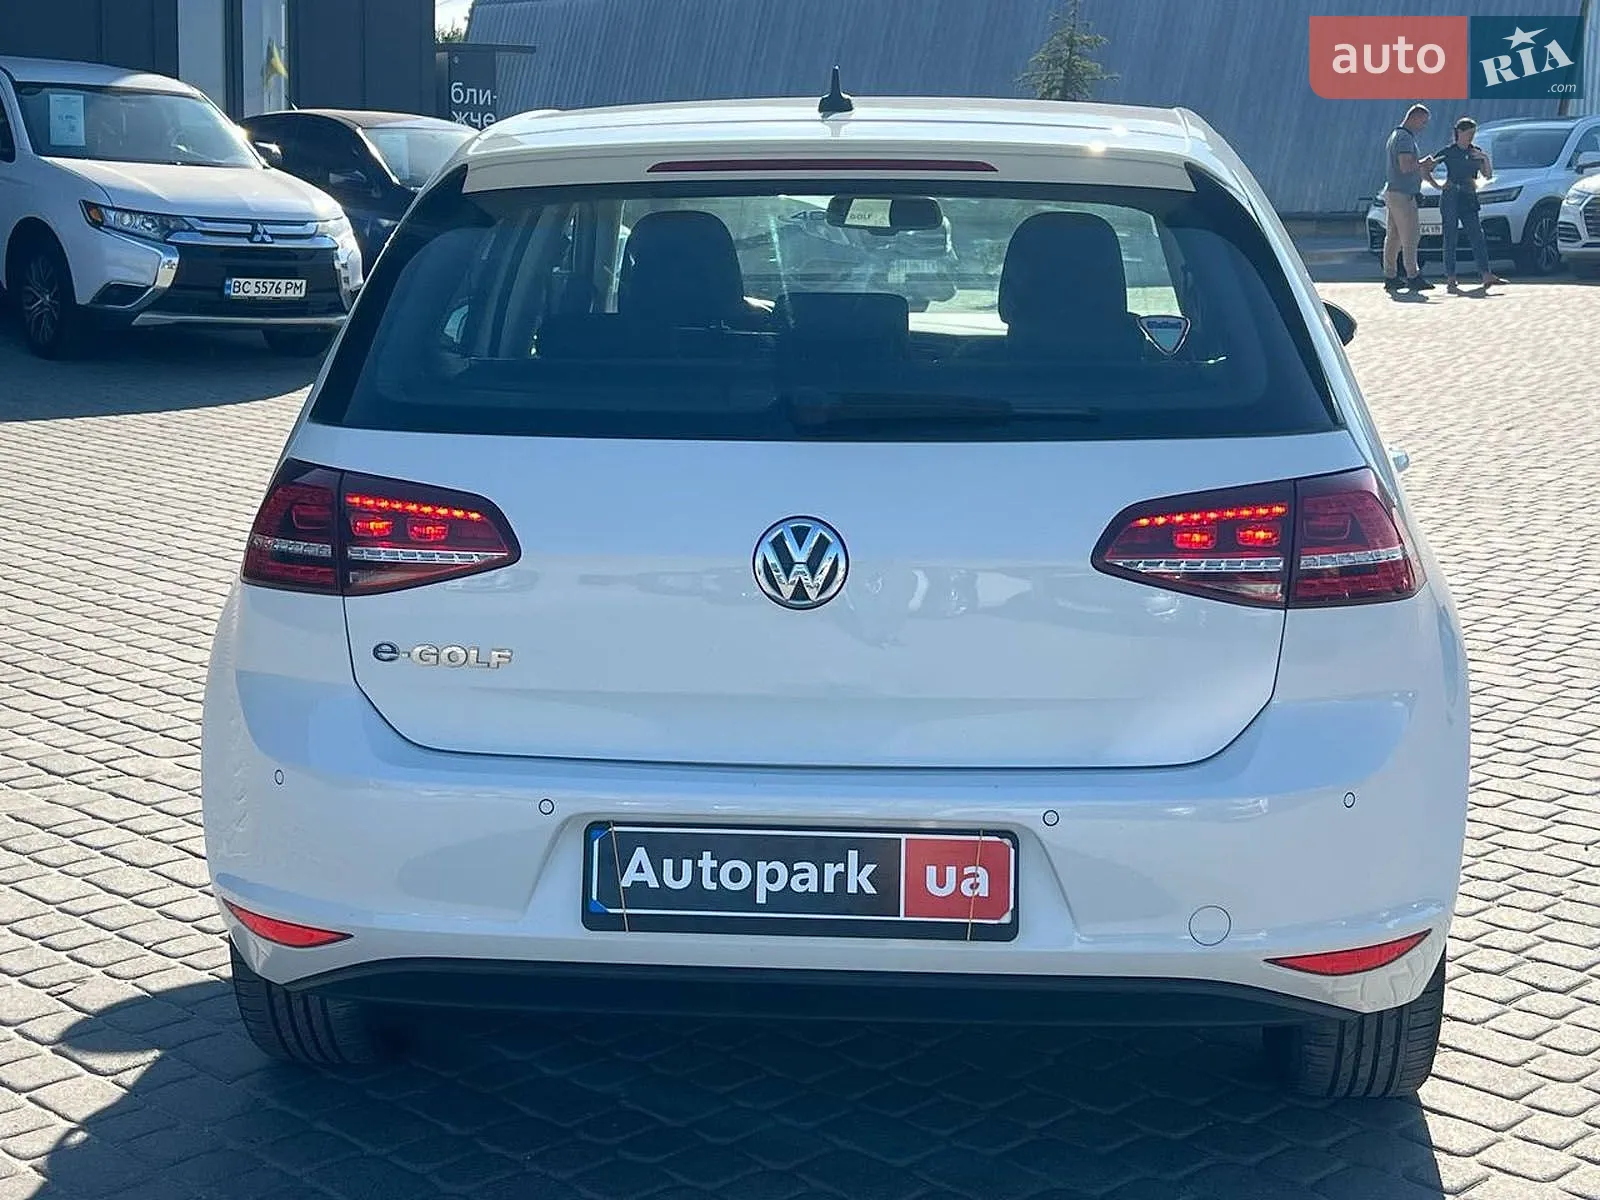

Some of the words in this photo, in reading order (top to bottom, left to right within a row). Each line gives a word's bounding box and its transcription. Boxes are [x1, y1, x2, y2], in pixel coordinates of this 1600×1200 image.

[450, 81, 498, 106] бли-
[232, 280, 251, 294] BC
[254, 281, 282, 295] 5576
[284, 281, 304, 295] PM
[758, 520, 844, 604] VW
[372, 642, 513, 669] e-GOLF
[620, 845, 878, 905] Autopark
[924, 862, 991, 898] ua
